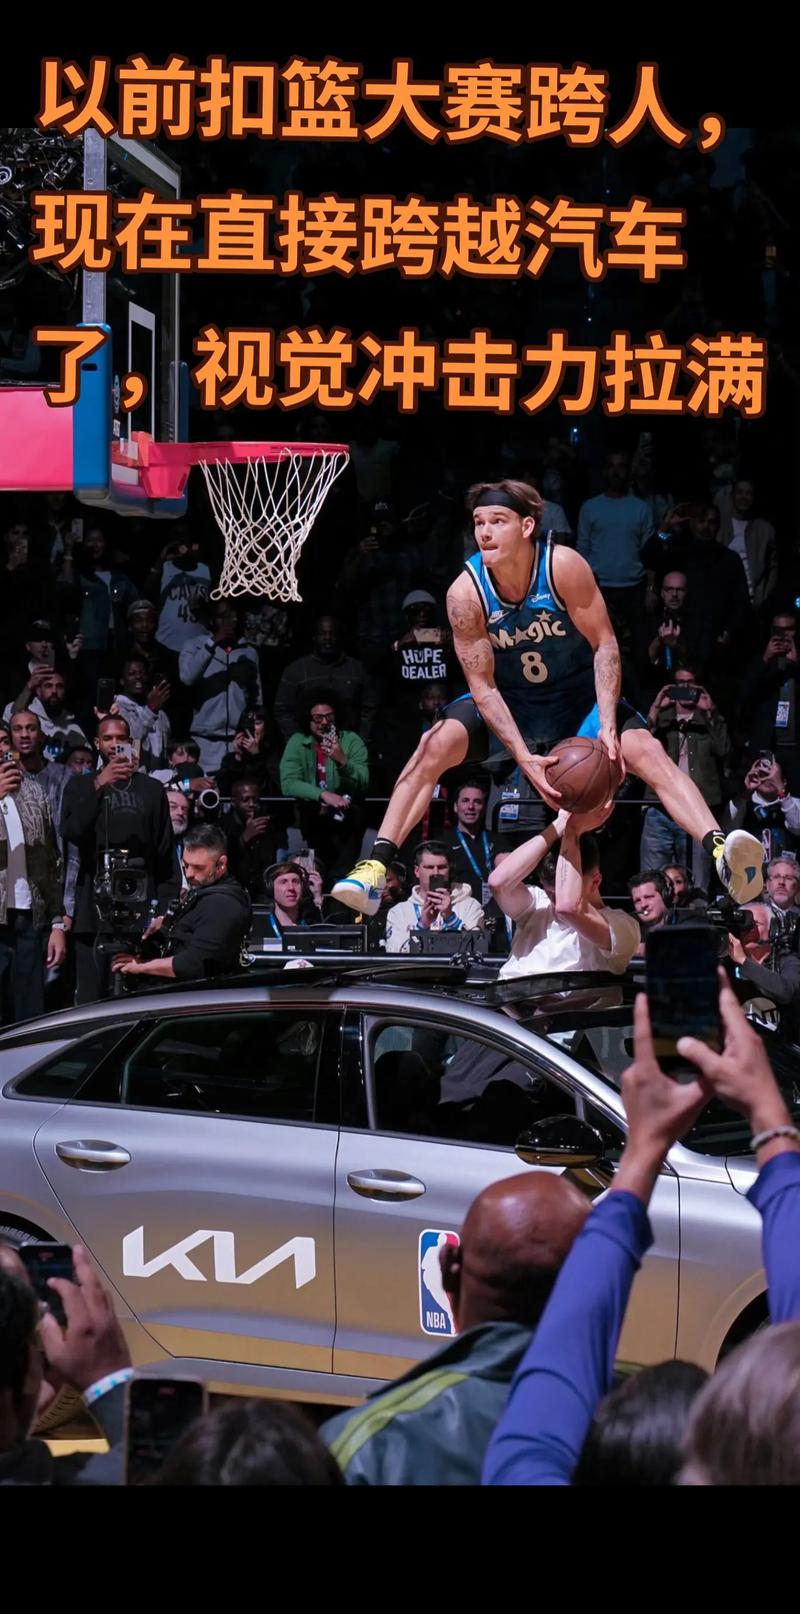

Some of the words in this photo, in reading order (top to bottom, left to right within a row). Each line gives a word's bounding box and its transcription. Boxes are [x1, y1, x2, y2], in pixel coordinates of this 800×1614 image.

[401, 663, 447, 680] DEALER
[520, 650, 549, 685] 8
[122, 1225, 316, 1290] KIA
[425, 1310, 447, 1329] NBA
